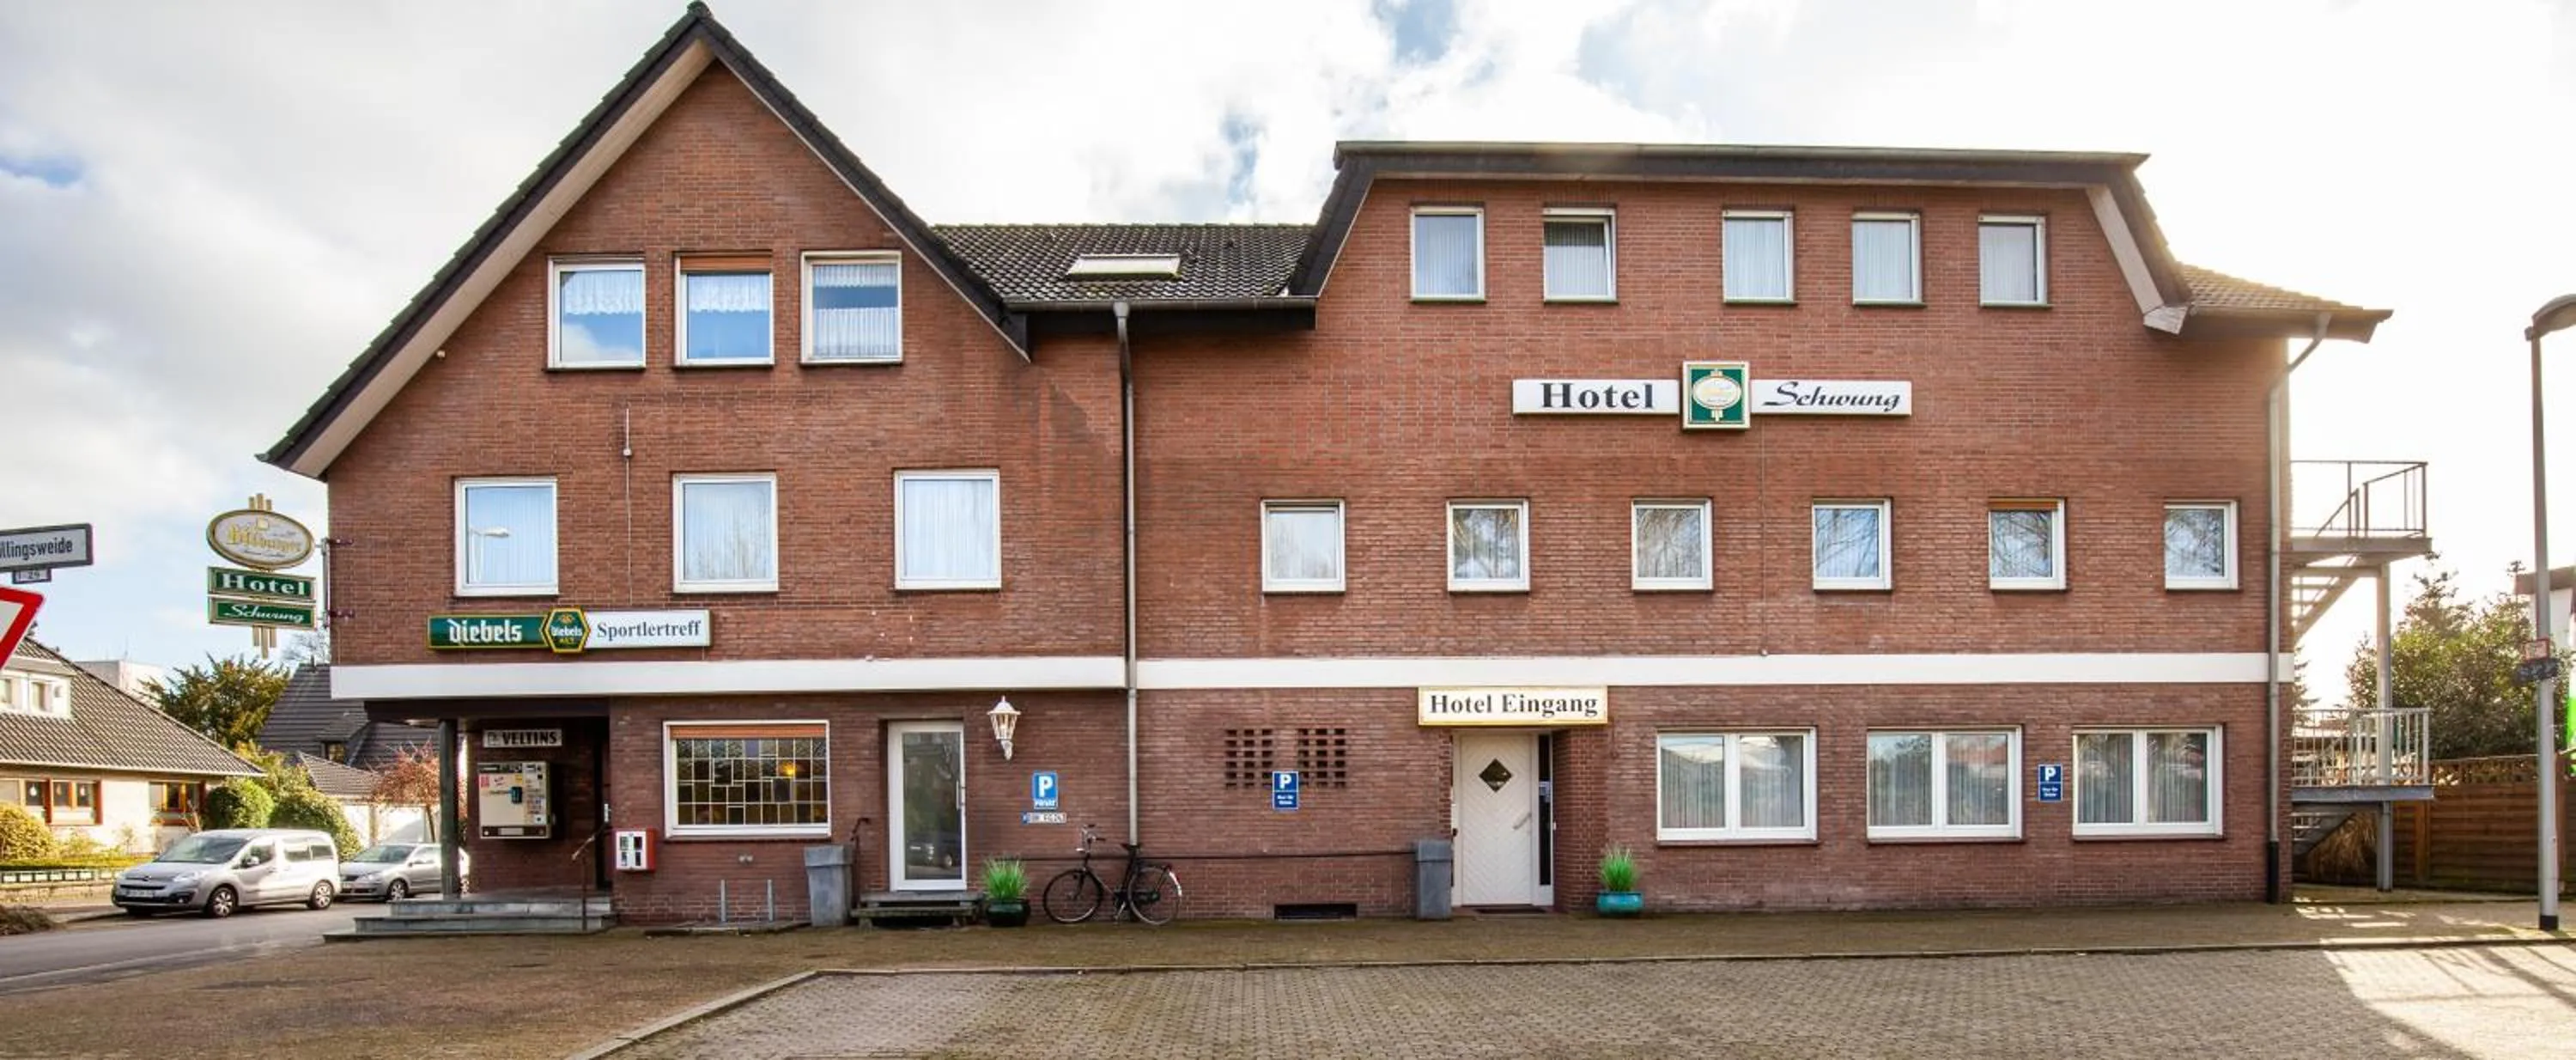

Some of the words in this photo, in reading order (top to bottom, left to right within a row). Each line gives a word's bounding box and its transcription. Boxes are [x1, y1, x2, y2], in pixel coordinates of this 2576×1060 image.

[1540, 381, 1654, 410] Hotel
[1763, 381, 1901, 412] Schwung
[222, 573, 306, 595] Hotel
[223, 604, 305, 624] Schwung
[597, 619, 702, 642] Sportlertreff
[1431, 694, 1492, 714] Hotel
[1502, 694, 1598, 717] Eingang
[501, 731, 557, 745] VELTINS
[1279, 774, 1291, 789] P
[2045, 767, 2057, 781] P
[1038, 776, 1053, 797] P
